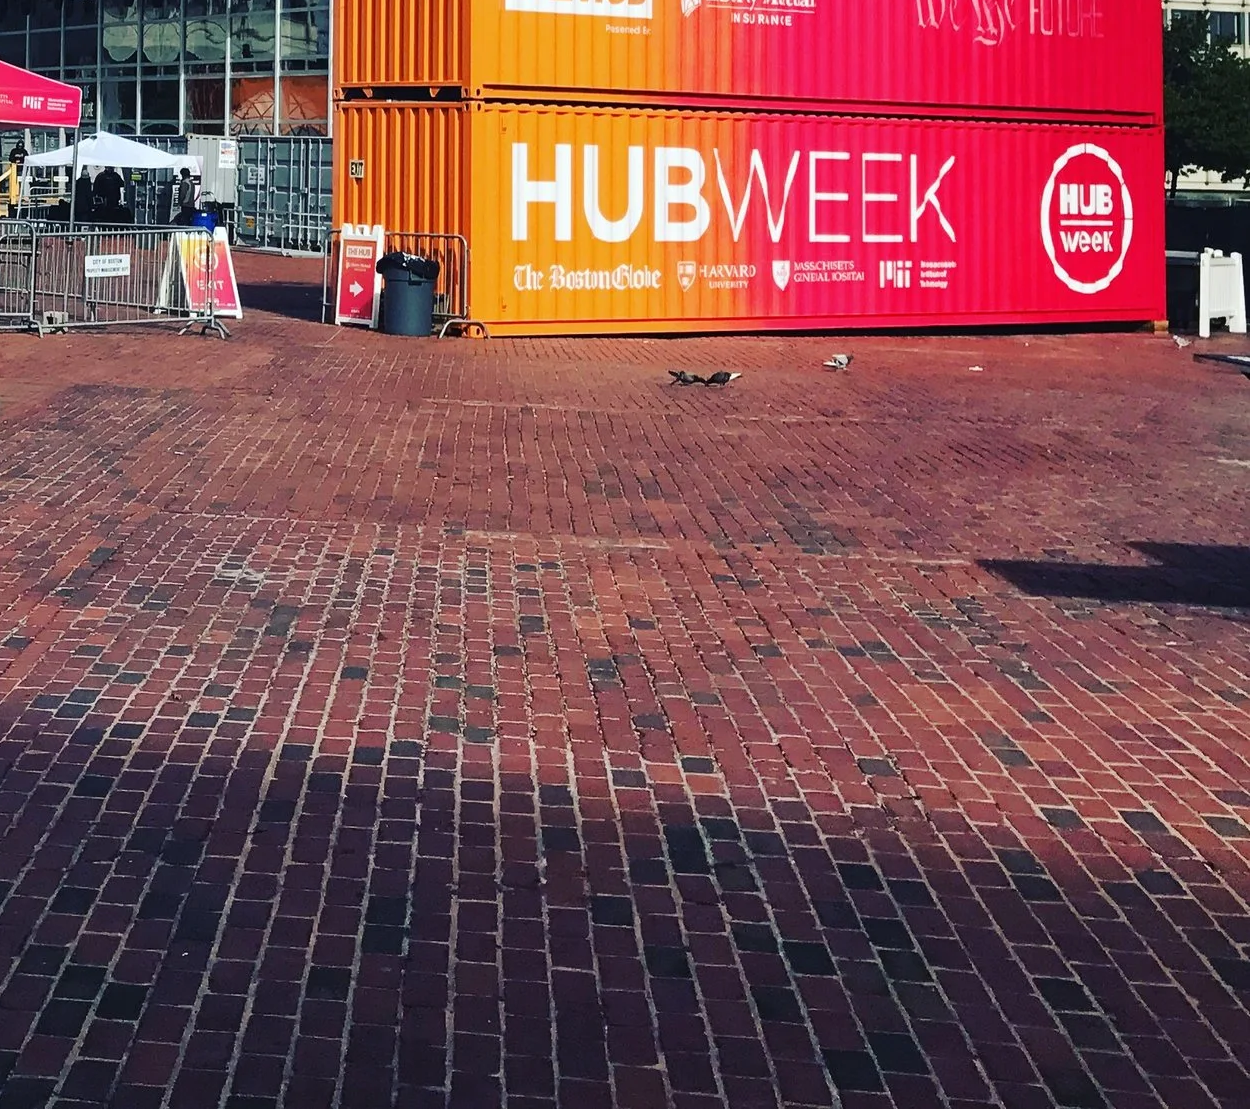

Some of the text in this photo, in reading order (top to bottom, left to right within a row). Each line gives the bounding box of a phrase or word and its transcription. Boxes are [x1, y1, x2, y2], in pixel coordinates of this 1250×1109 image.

[350, 161, 364, 176] EXIT
[1059, 183, 1114, 216] HUB
[1060, 230, 1114, 254] week
[513, 263, 544, 291] The
[548, 263, 611, 291] Boston
[700, 264, 757, 278] HARVARD
[196, 279, 224, 291] EXIT
